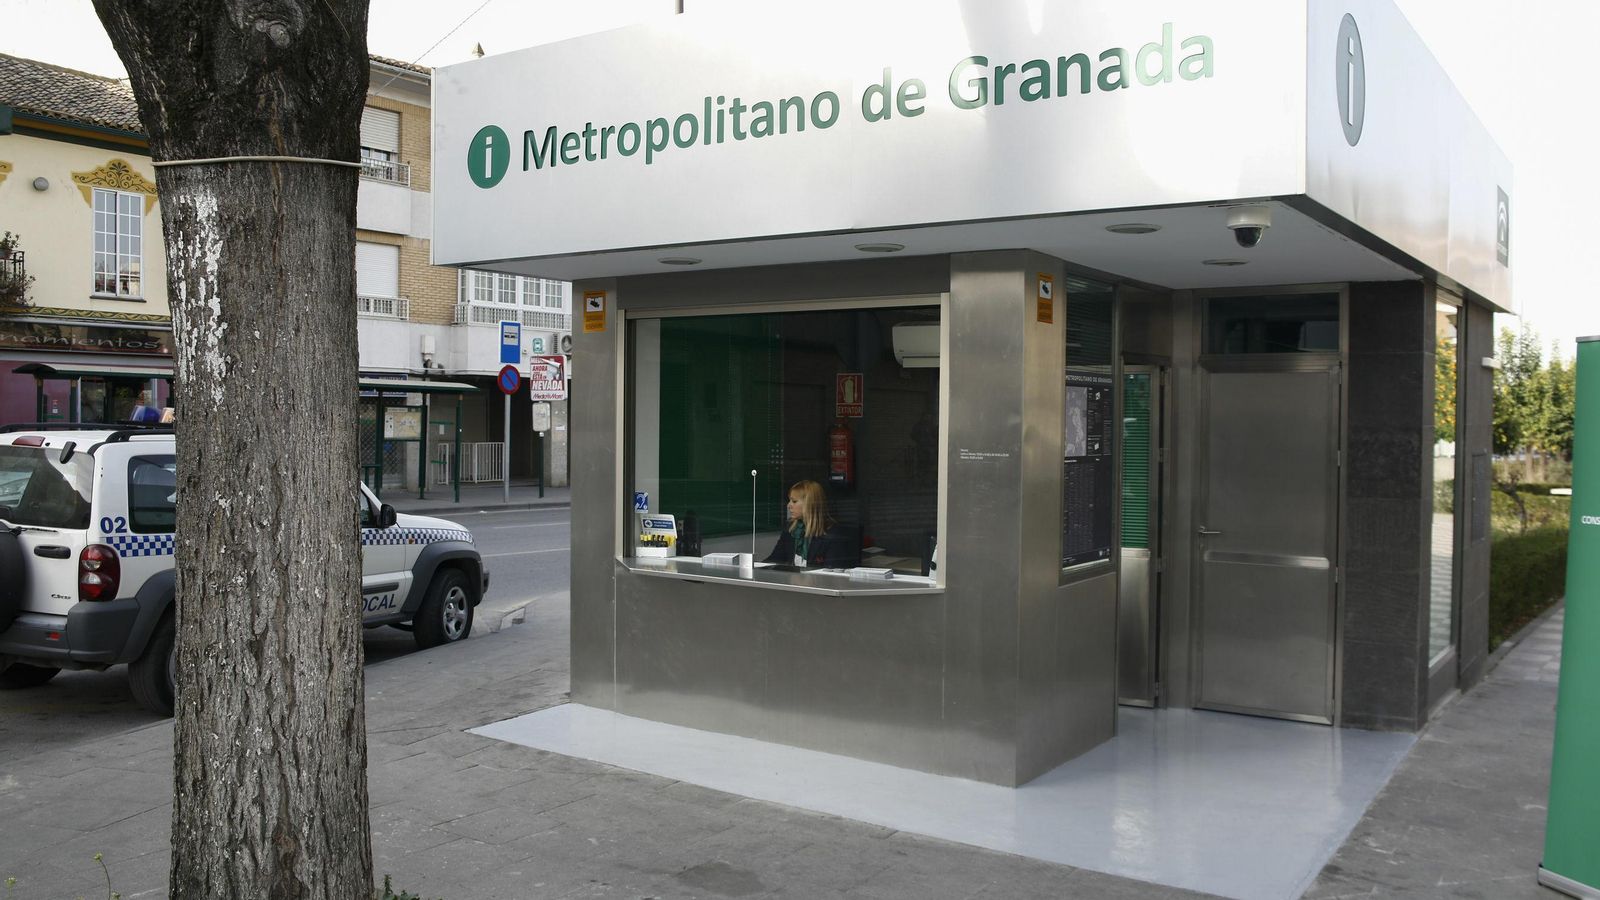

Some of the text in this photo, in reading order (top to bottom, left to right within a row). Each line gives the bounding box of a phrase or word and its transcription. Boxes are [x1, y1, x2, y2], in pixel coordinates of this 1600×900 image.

[522, 22, 1215, 171] Metropolitano de Granada
[532, 380, 562, 390] NEVADA
[837, 405, 862, 415] EXTINTOR
[100, 516, 128, 534] 02
